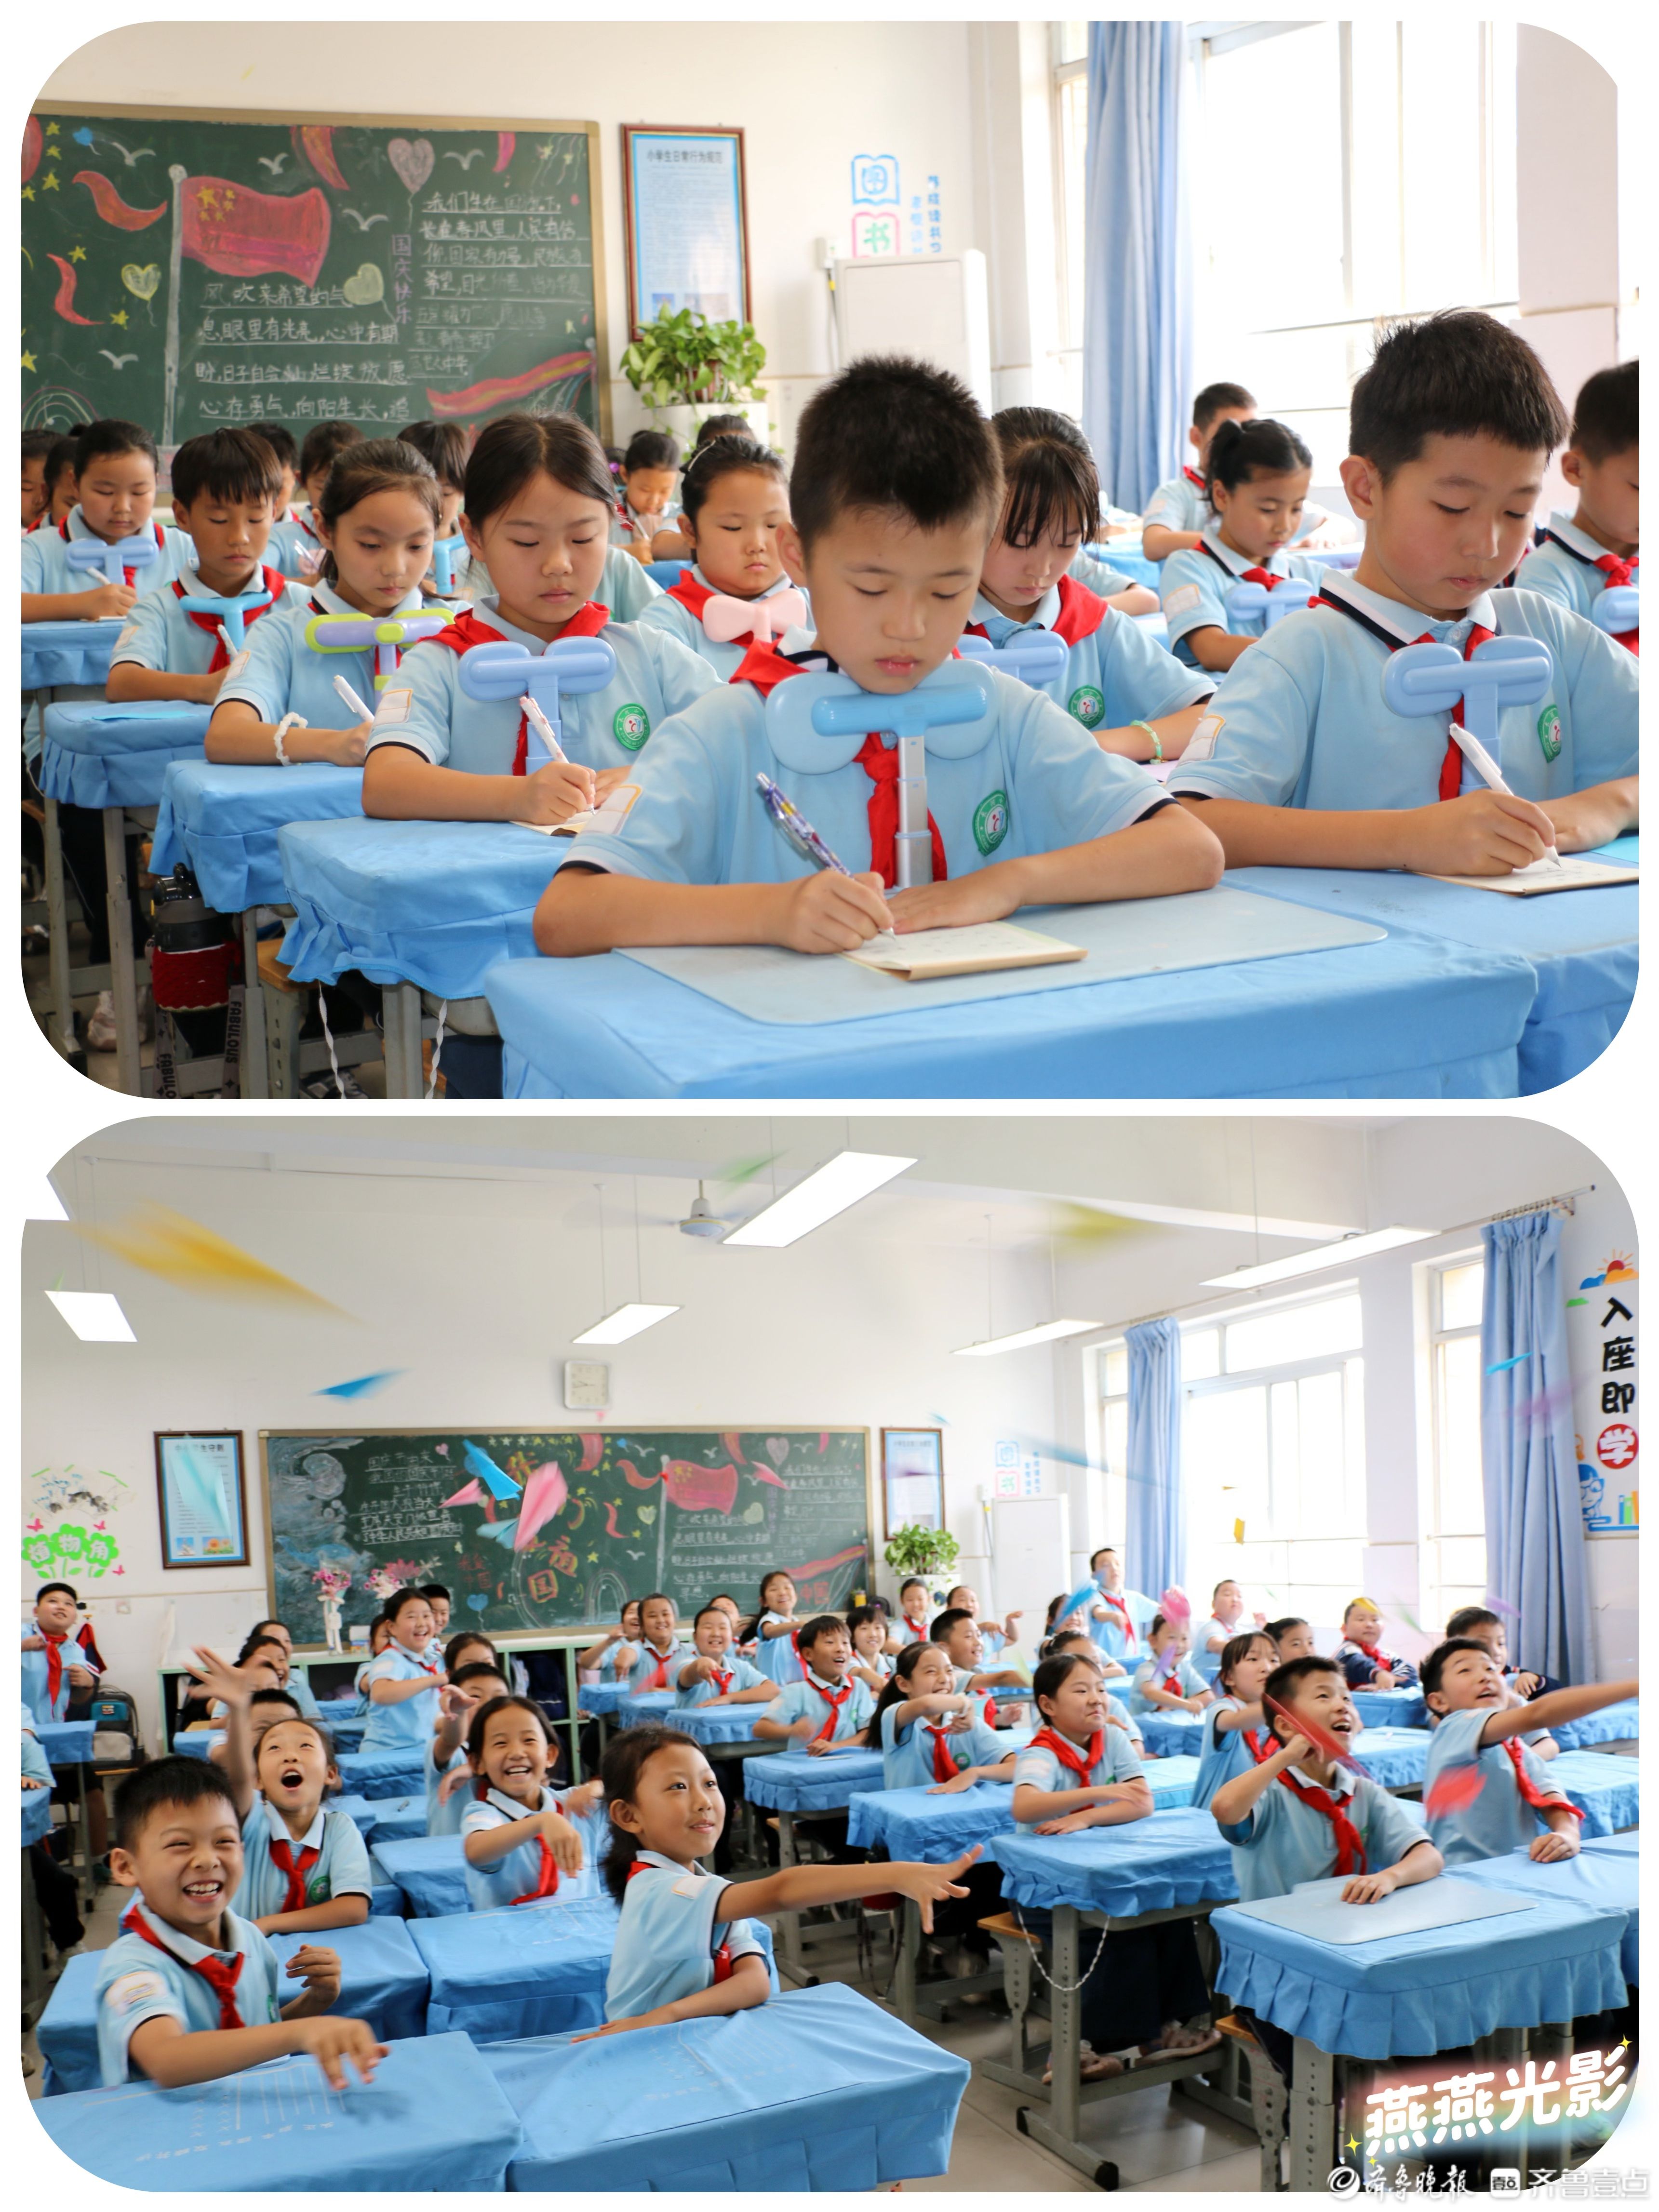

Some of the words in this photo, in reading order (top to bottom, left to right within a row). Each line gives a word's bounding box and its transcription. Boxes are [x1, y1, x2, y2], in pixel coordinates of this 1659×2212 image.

[391, 234, 413, 324] 国庆快乐
[226, 1001, 242, 1064] FABULOUS
[1599, 1296, 1635, 1465] 入座即学
